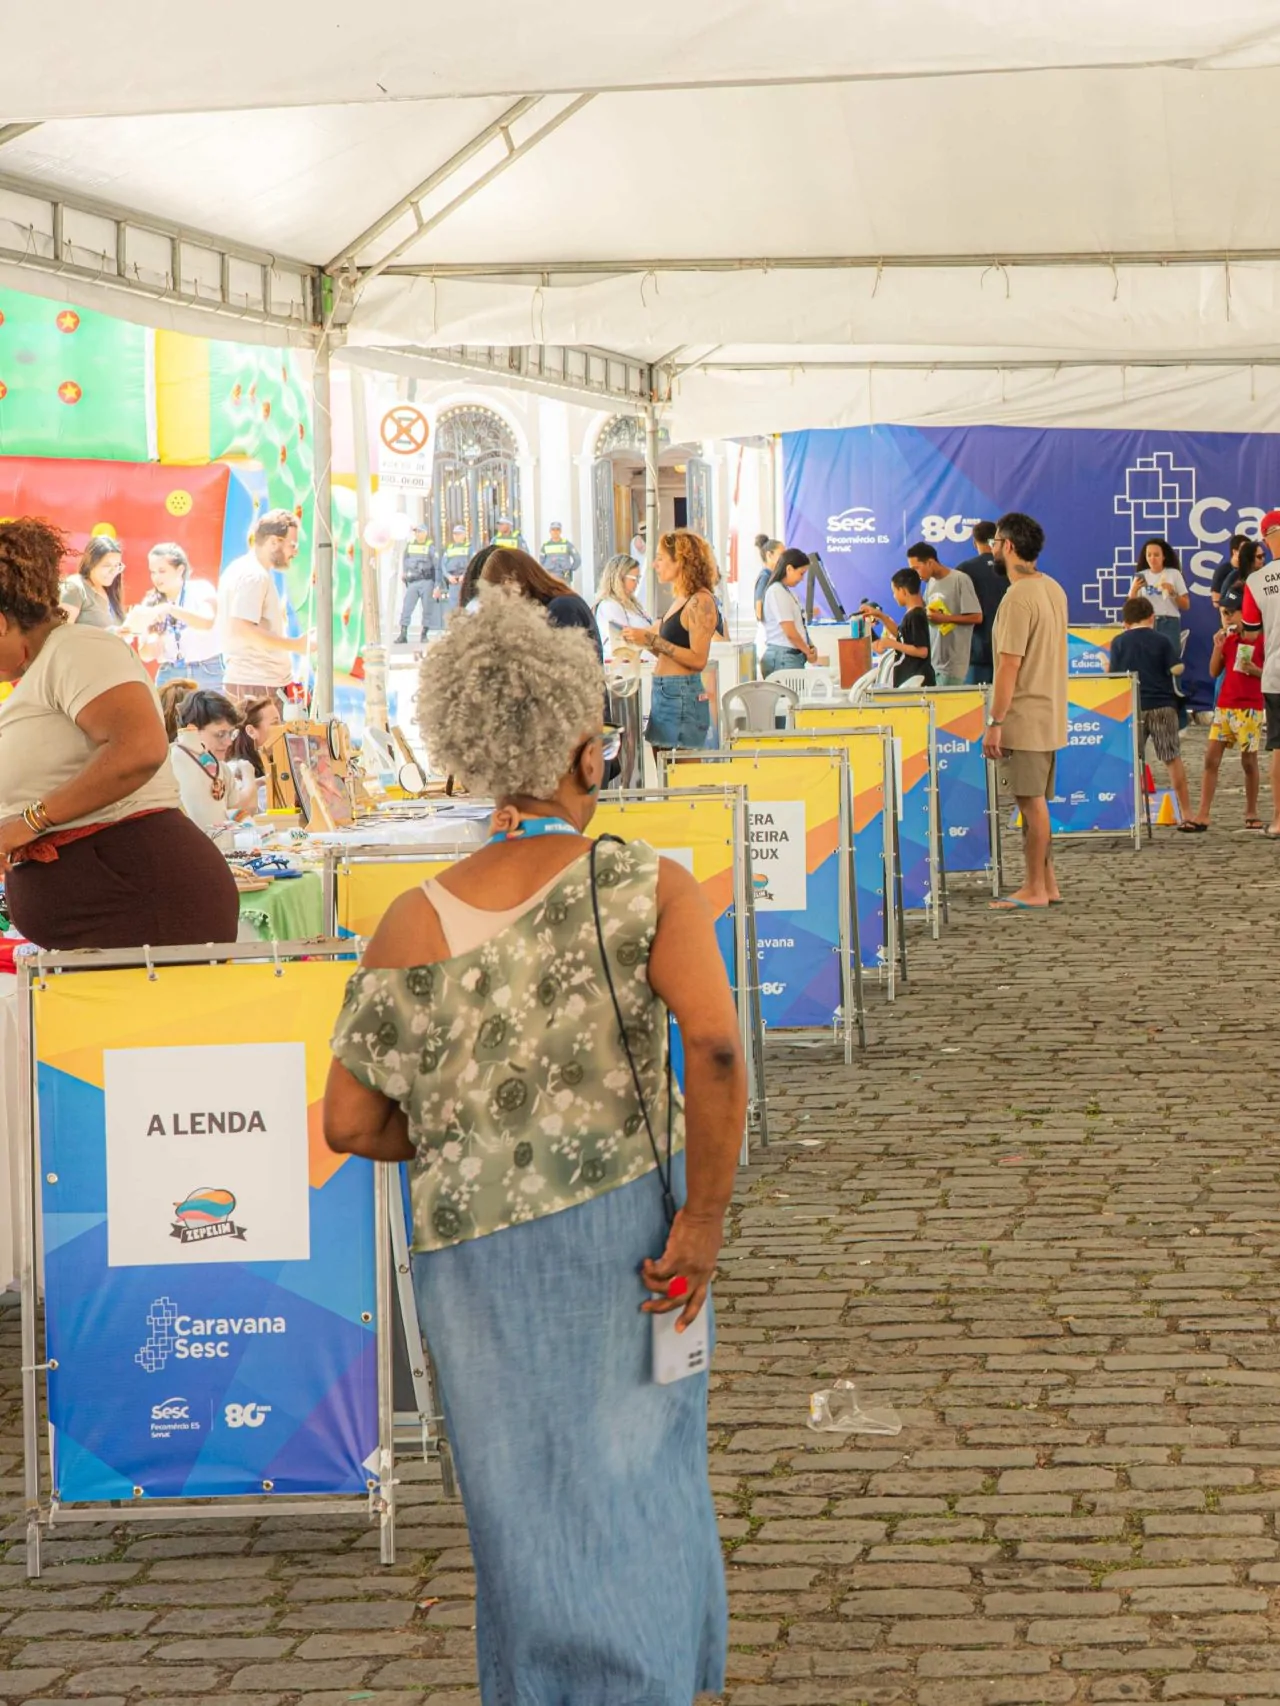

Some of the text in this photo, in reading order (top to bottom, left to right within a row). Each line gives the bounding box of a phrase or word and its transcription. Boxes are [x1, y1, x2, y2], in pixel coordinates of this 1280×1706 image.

[826, 515, 876, 532] Sesc
[1263, 585, 1279, 596] TIRO
[1071, 660, 1104, 669] Educa
[1067, 719, 1100, 732] Sesc
[1067, 734, 1104, 746] azer
[748, 813, 775, 826] ERA
[750, 830, 790, 843] REIRA
[751, 848, 780, 860] OUX
[757, 938, 795, 948] avana
[147, 1110, 267, 1136] A LENDA
[174, 1315, 286, 1336] Caravana
[174, 1338, 230, 1359] Sesc
[151, 1405, 190, 1420] Sesc
